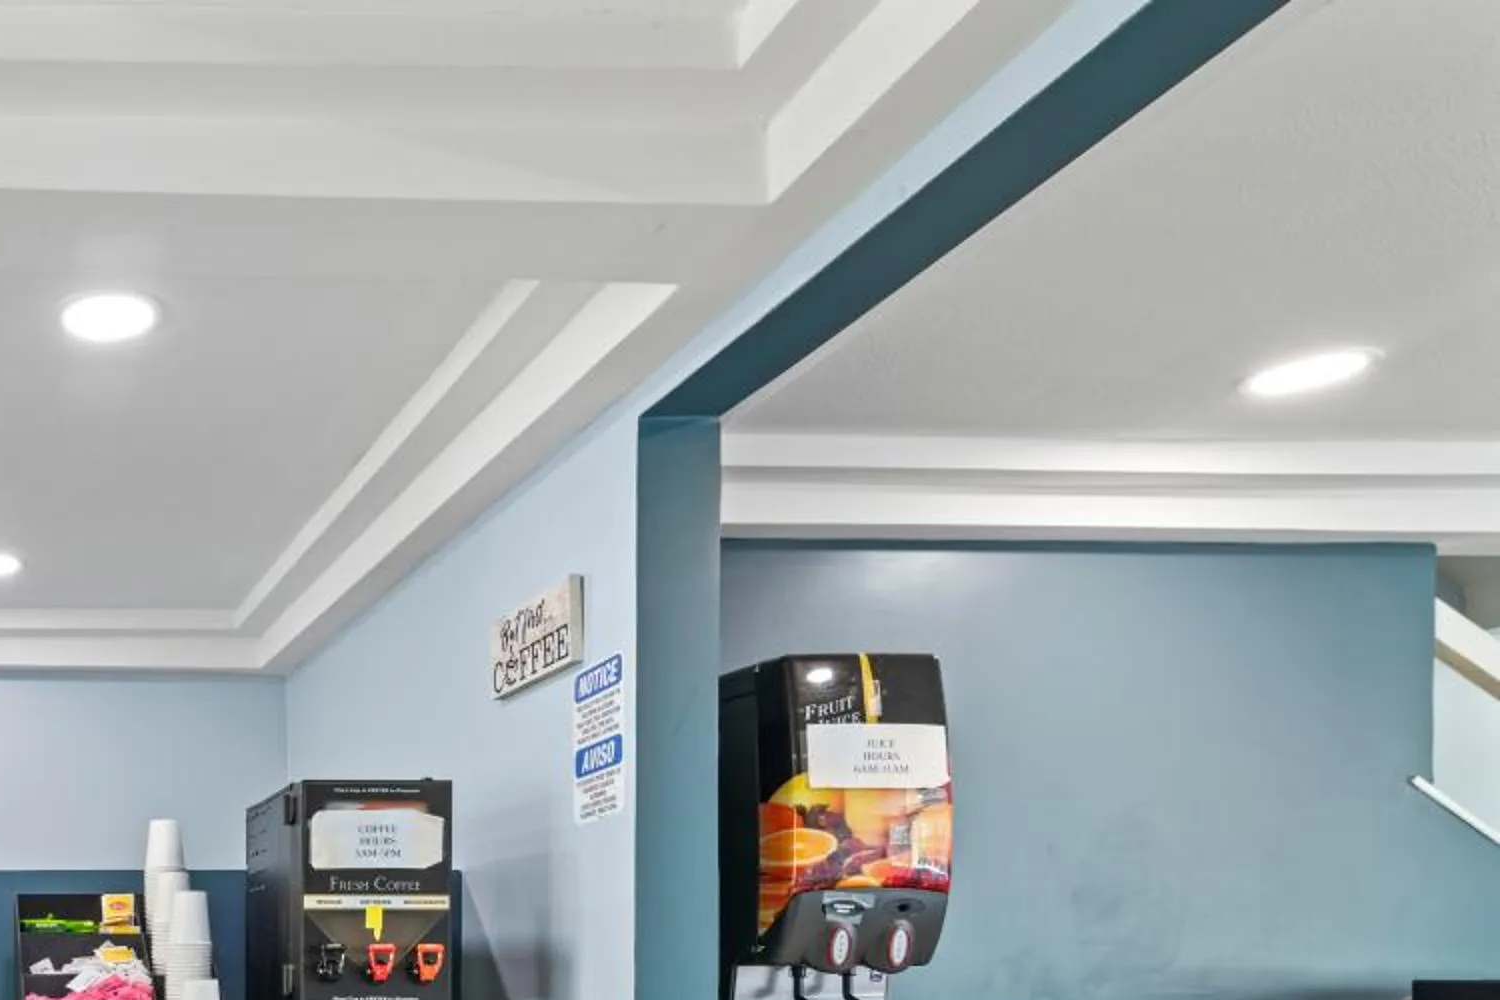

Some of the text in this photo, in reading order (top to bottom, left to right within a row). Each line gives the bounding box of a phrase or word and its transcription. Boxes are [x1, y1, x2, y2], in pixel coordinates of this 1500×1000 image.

[493, 622, 569, 693] COFFEE
[579, 658, 619, 698] NOTICE
[804, 695, 856, 721] FRUIT
[581, 740, 615, 773] AVISO
[863, 751, 901, 761] HOURS
[373, 874, 421, 891] COFFEE
